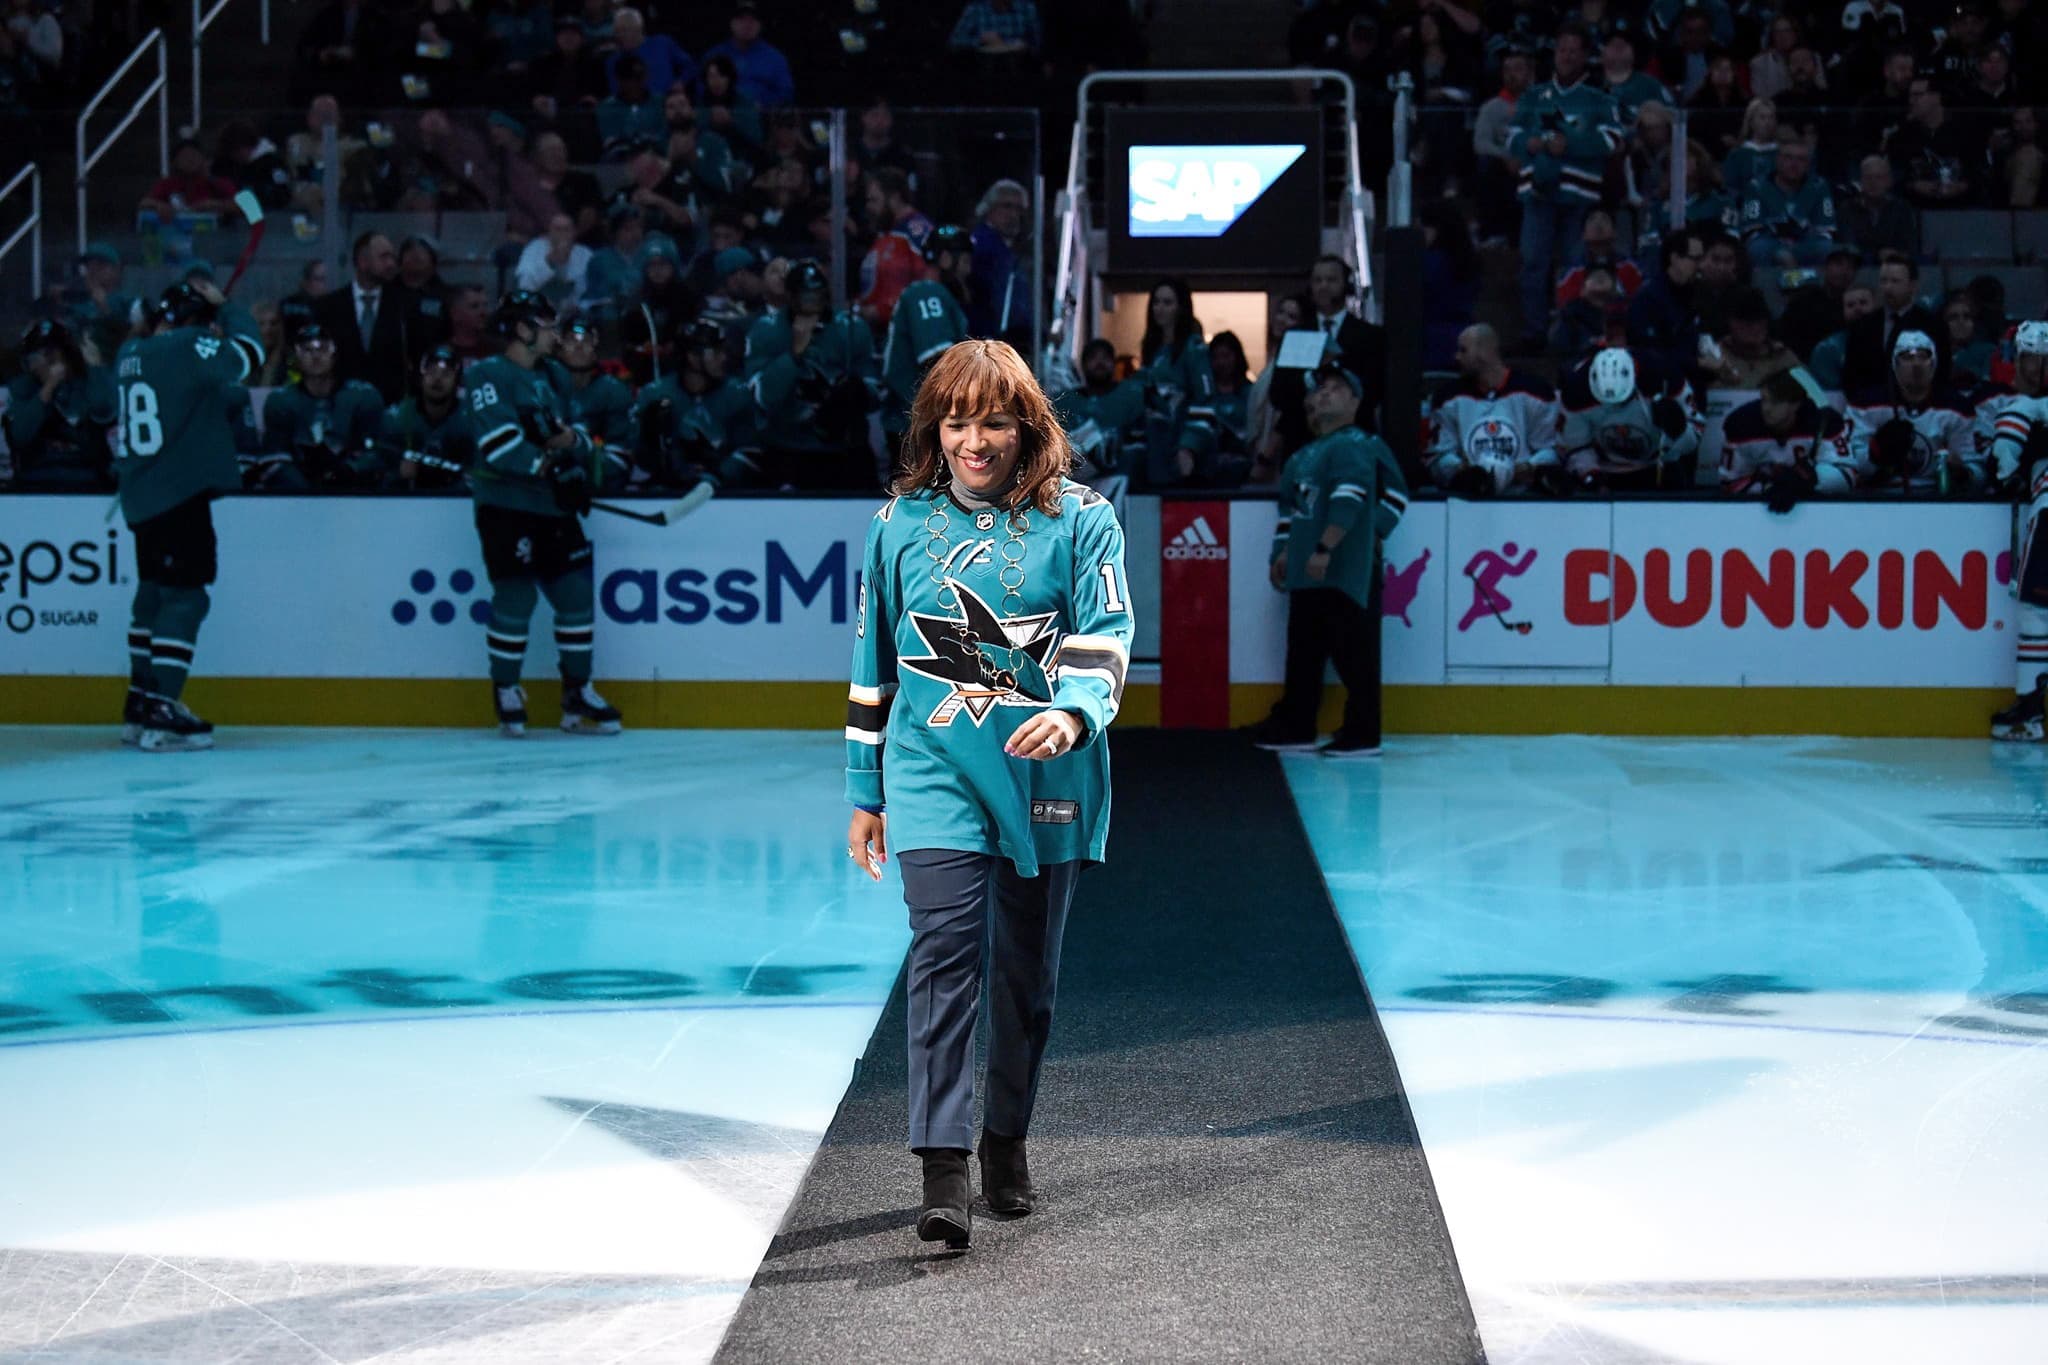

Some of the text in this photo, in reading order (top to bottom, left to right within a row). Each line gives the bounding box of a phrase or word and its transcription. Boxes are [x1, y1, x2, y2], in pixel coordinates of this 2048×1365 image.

[1131, 160, 1262, 222] SAP
[918, 296, 944, 320] 19
[470, 381, 499, 412] 28
[1162, 544, 1228, 561] adidas
[588, 540, 863, 624] assM
[40, 611, 98, 626] SUGAR
